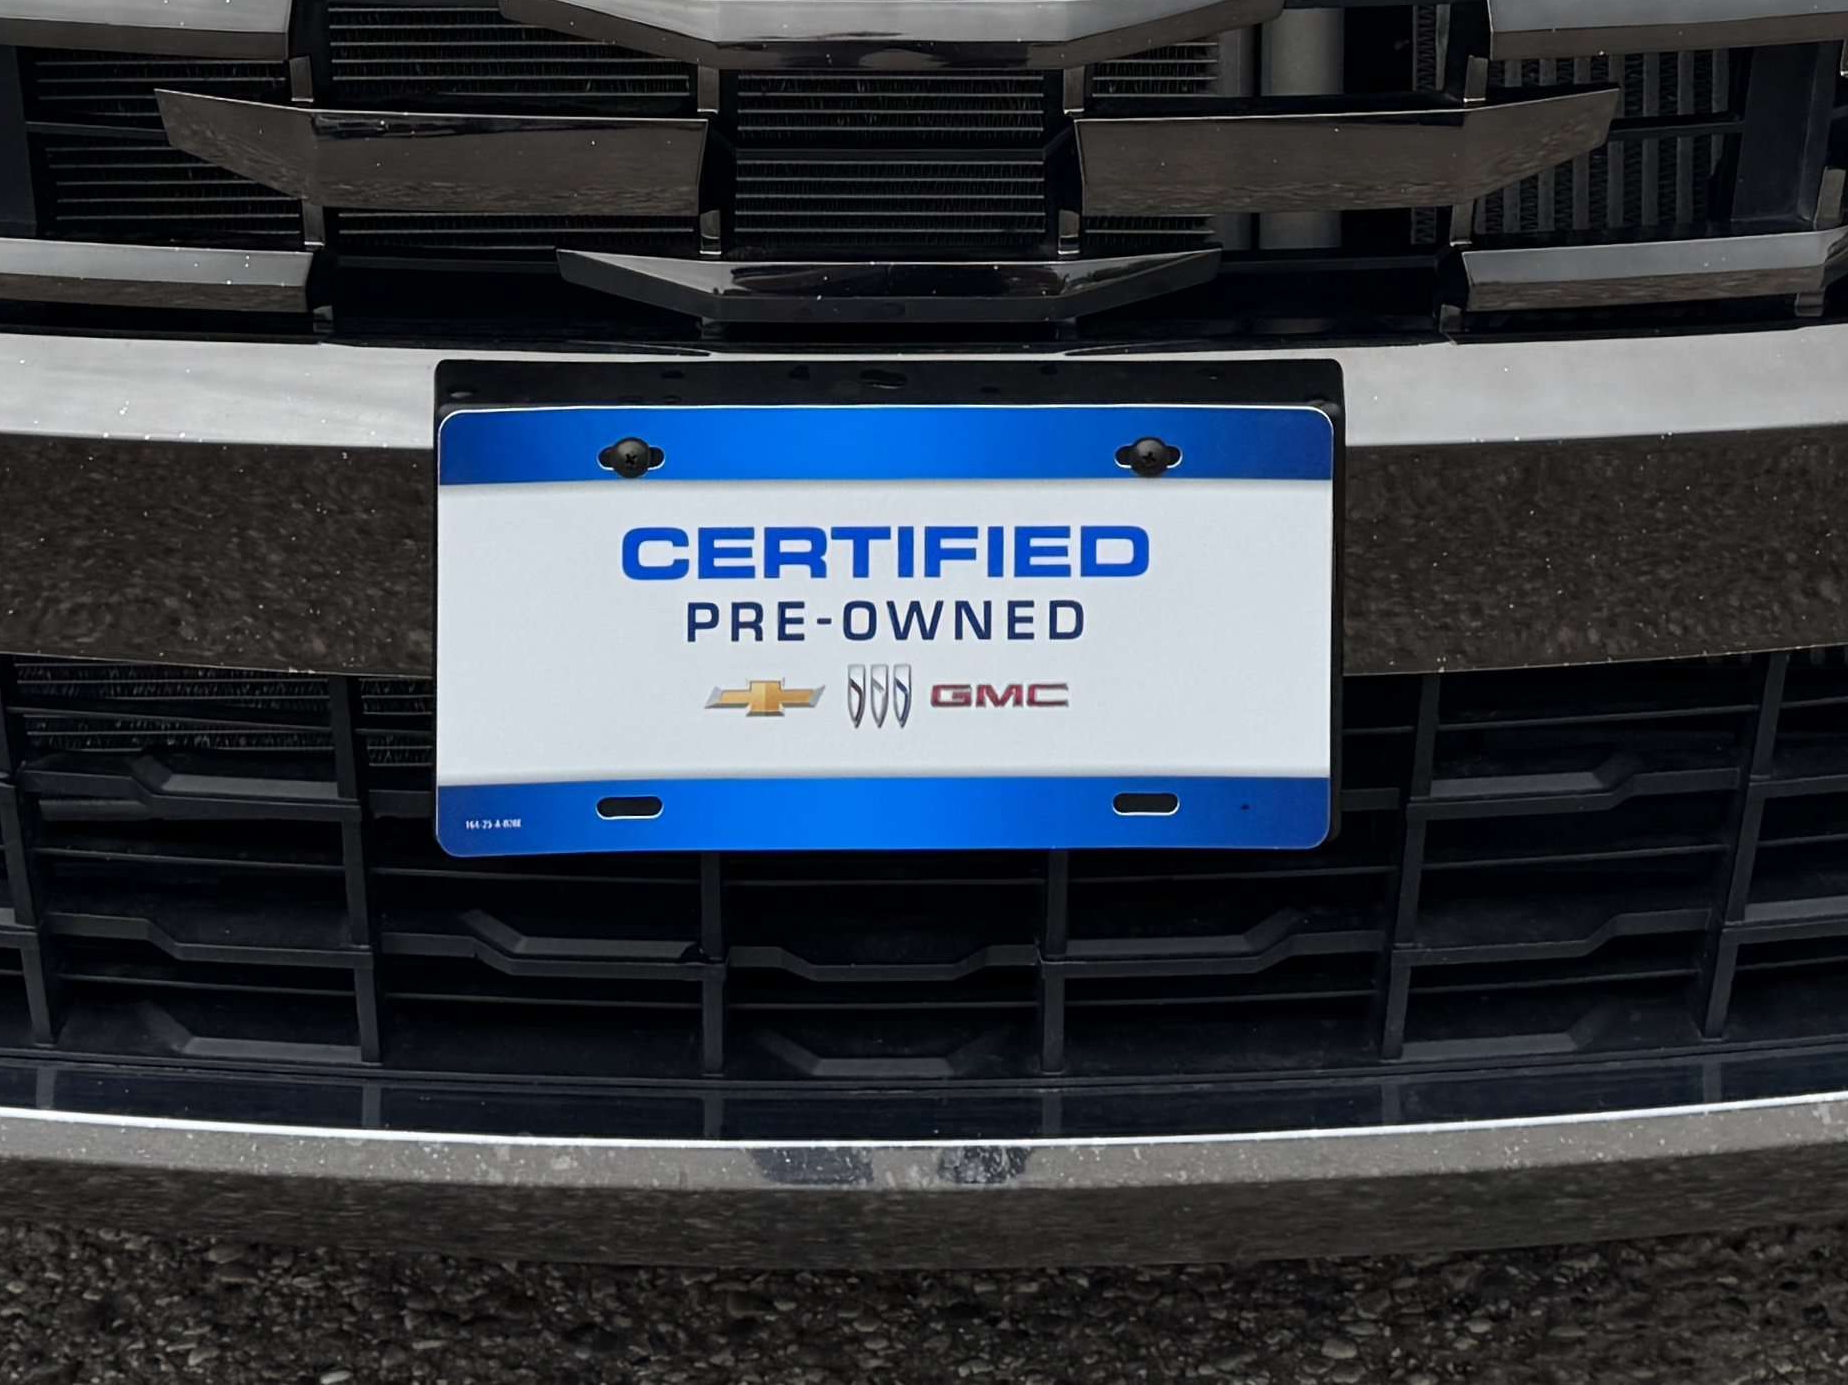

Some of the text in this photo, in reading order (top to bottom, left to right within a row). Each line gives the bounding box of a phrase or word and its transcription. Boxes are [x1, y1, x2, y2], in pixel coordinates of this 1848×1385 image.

[621, 525, 1150, 581] CERTIFIED
[686, 600, 1086, 643] PRE-OWNED
[930, 683, 1070, 709] GMC
